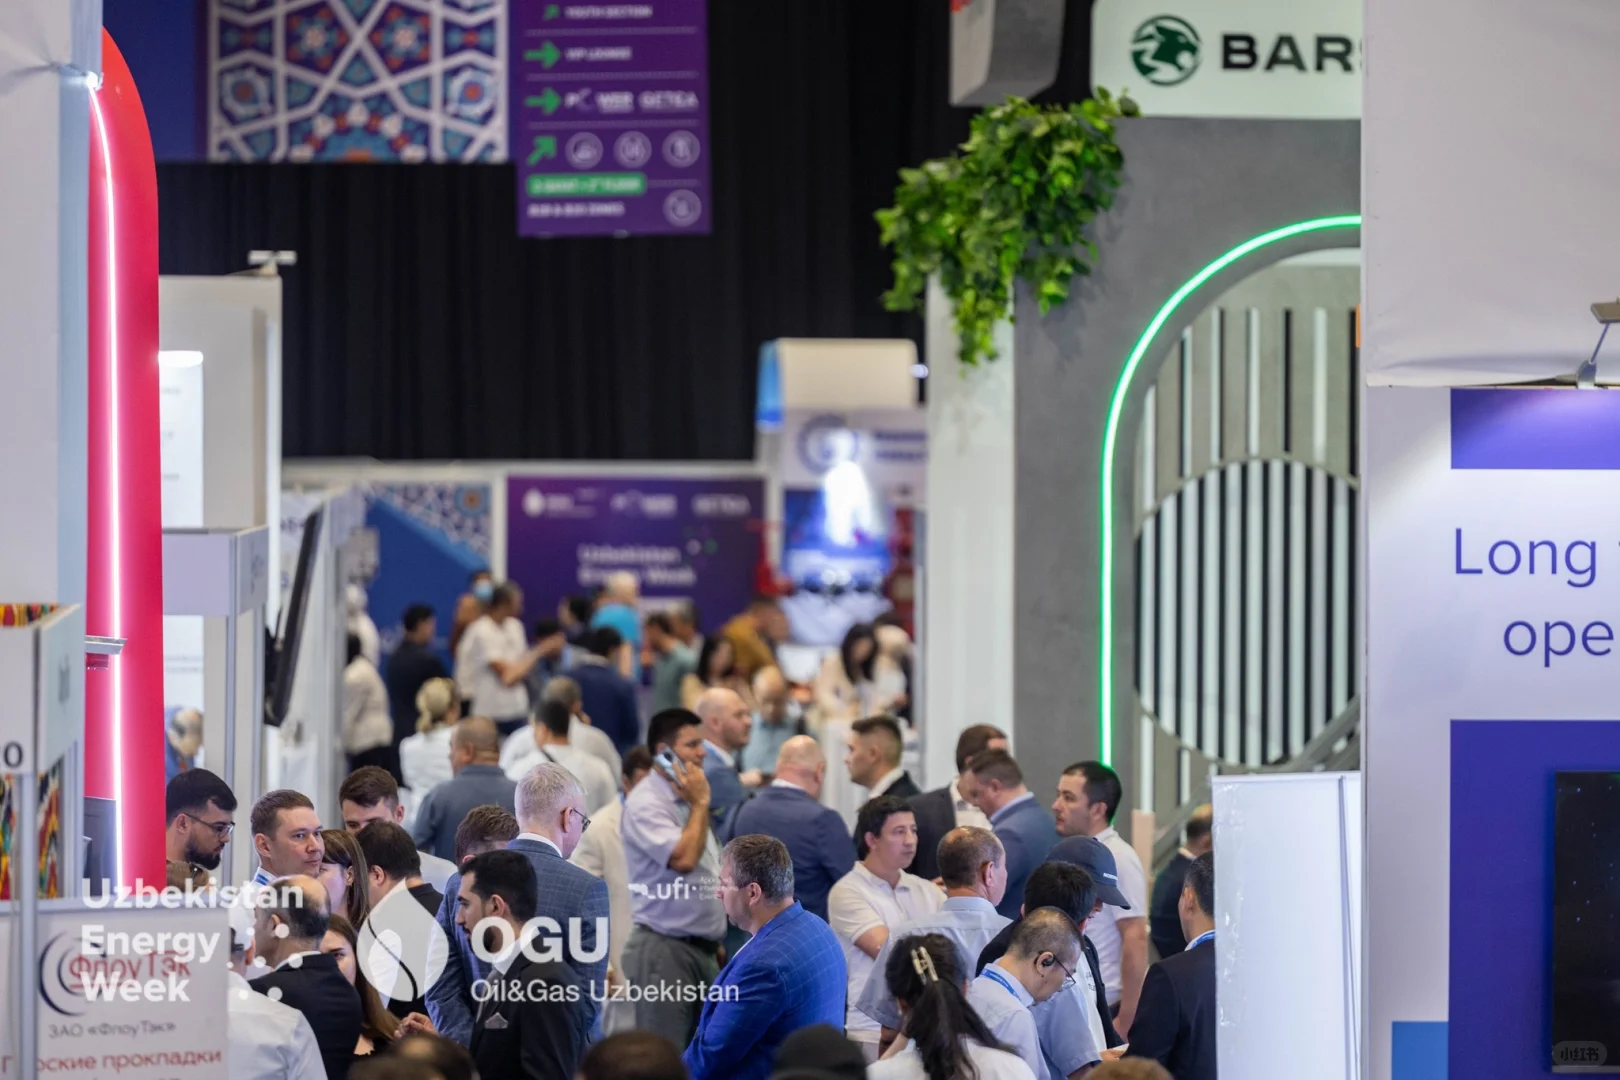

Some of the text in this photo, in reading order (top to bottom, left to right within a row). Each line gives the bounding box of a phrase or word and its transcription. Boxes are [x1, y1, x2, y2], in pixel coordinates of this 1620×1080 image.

[1222, 34, 1362, 73] BAR
[1455, 527, 1597, 588] Long
[1503, 620, 1614, 668] ope
